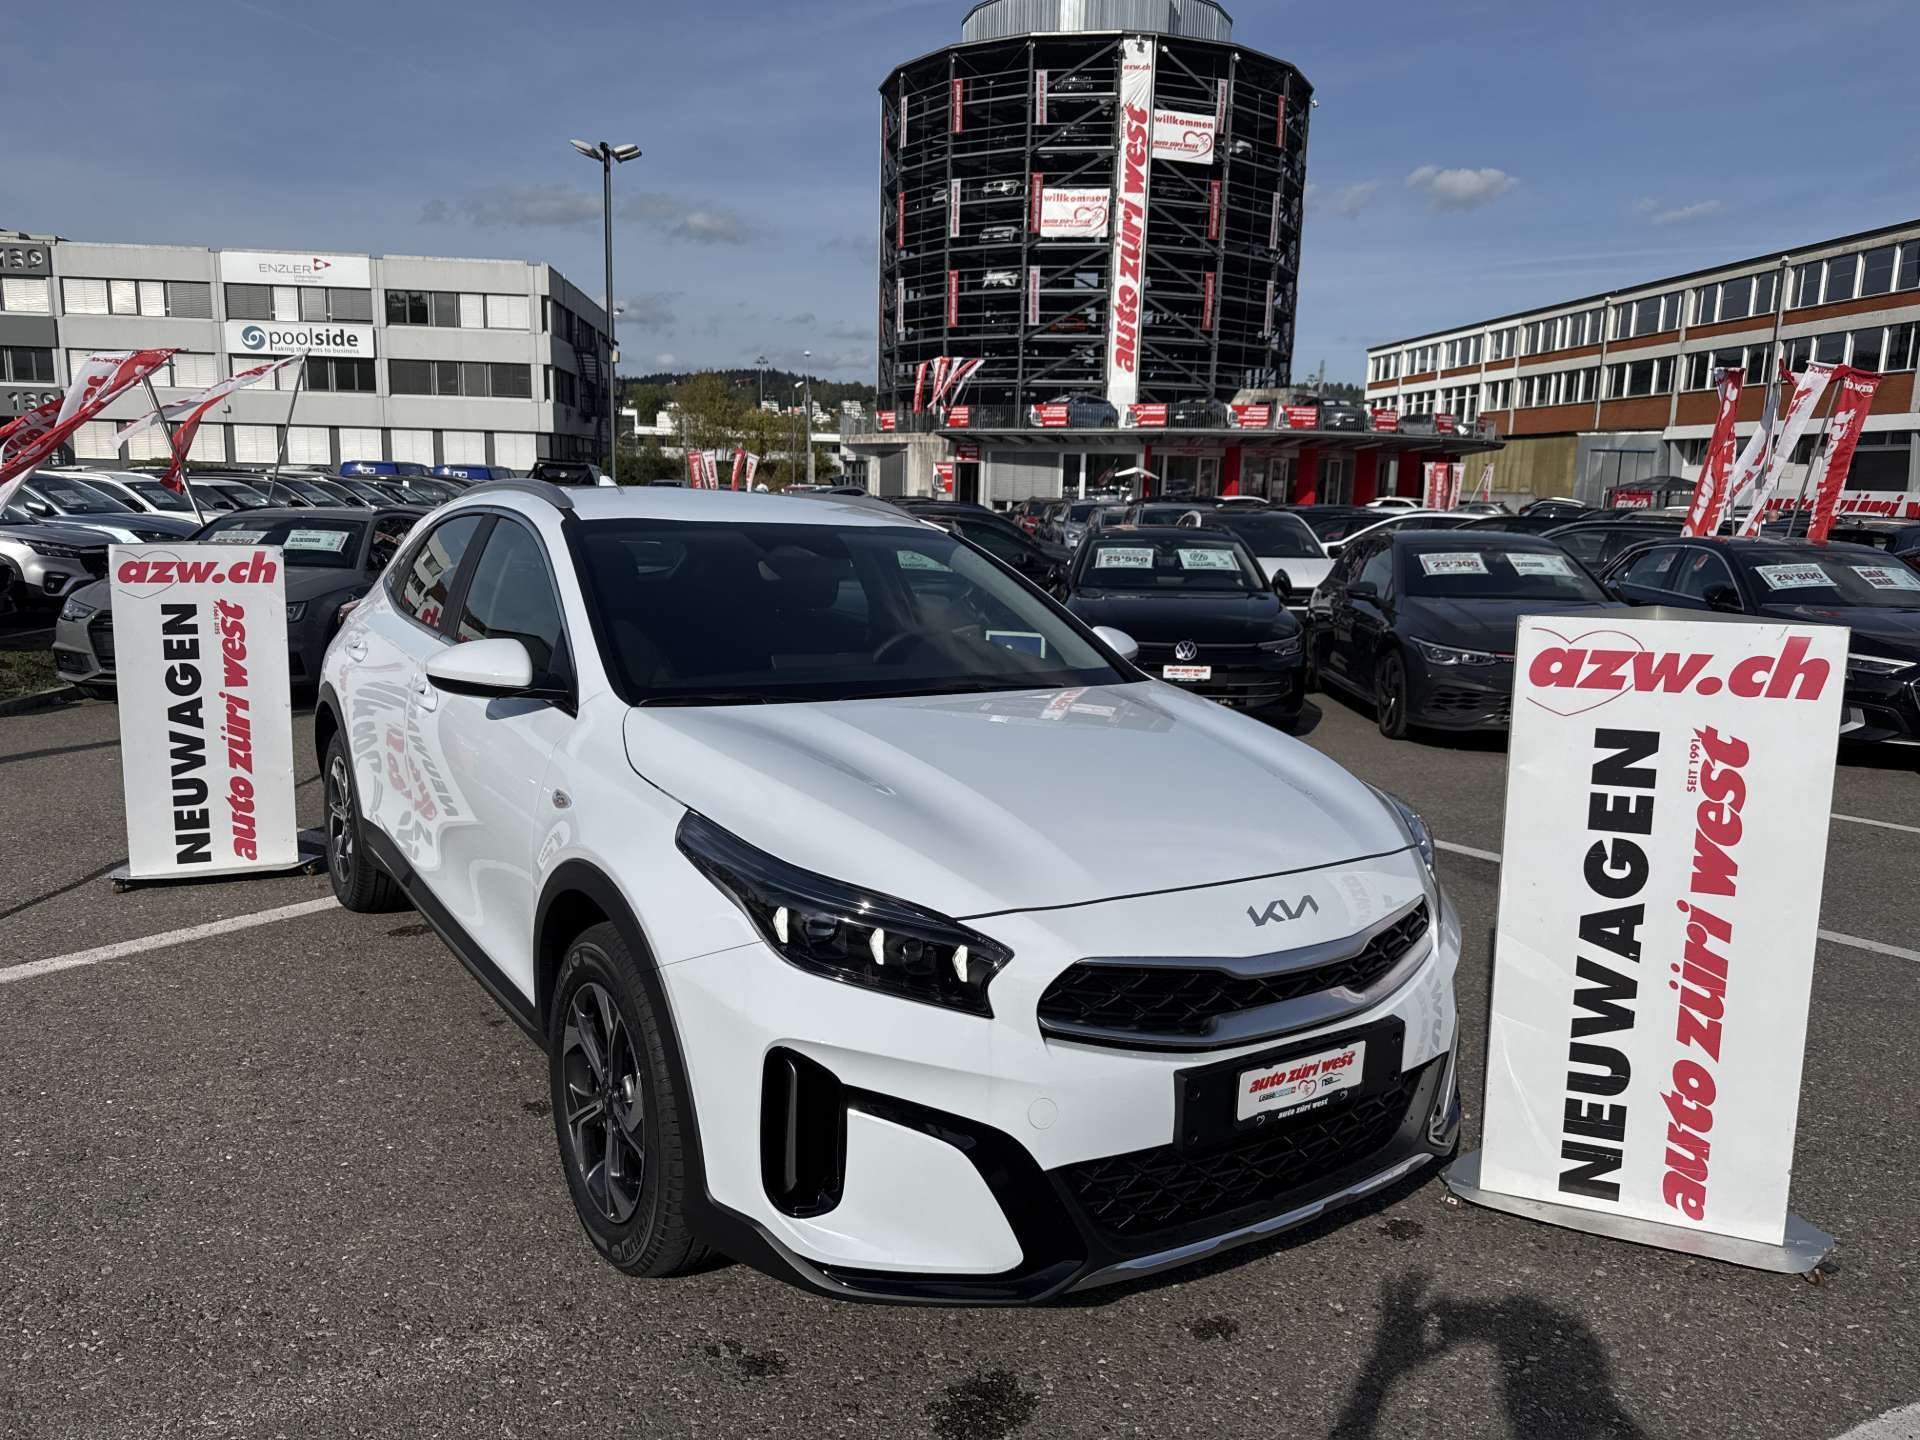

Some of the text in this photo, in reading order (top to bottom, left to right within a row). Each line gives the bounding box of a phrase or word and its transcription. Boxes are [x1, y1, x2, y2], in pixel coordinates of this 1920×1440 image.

[1154, 114, 1213, 129] willkommen
[1044, 193, 1107, 203] willkommen
[1114, 102, 1148, 373] auto züri west
[259, 263, 311, 274] ENZLER
[269, 328, 358, 351] poolside
[117, 551, 277, 584] azw.ch
[1528, 636, 1831, 701] azw.ch
[160, 603, 213, 865] NEUWAGEN
[214, 598, 257, 862] auto züri west
[1687, 738, 1701, 793] SEIT 1991
[1558, 727, 1661, 1203] NEUWAGEN
[1658, 724, 1750, 1222] auto züri west
[1249, 1071, 1286, 1093] auto
[1286, 1060, 1321, 1083] züri
[1321, 1050, 1356, 1072] west
[1278, 1098, 1329, 1119] auto züri west
